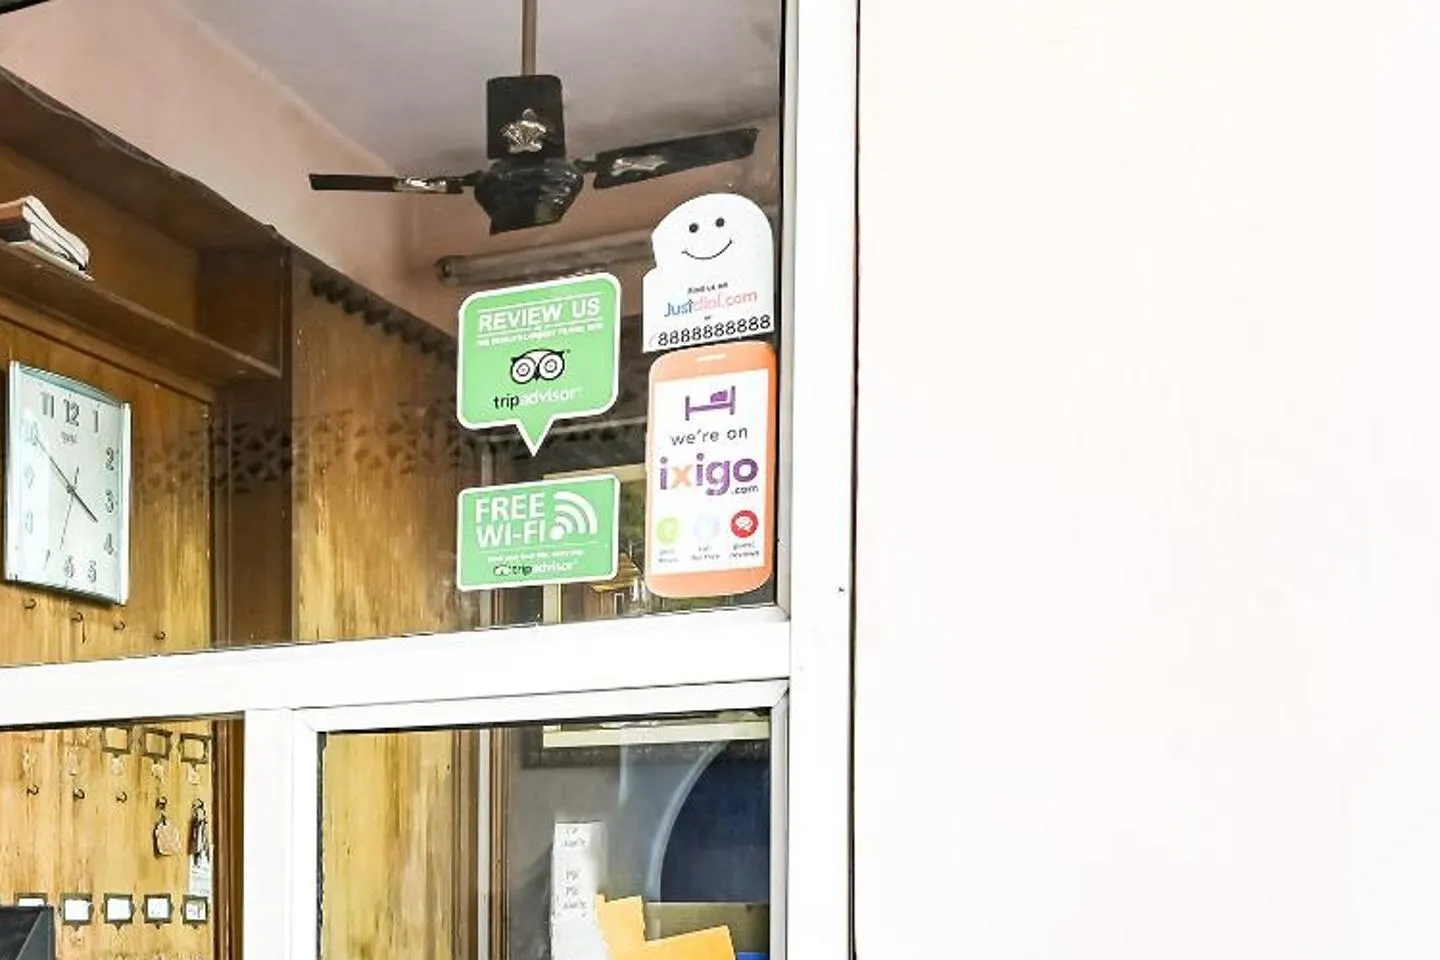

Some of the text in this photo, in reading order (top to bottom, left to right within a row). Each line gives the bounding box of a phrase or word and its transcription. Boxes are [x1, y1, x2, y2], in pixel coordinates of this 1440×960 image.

[479, 297, 601, 333] REVIEW US
[664, 291, 758, 318] Justdial.com
[658, 314, 771, 346] 8888888888
[63, 398, 80, 427] 12
[493, 387, 582, 410] tripadvisor
[670, 427, 747, 446] we're on
[660, 453, 759, 496] ixigo
[475, 492, 546, 523] FREE
[477, 519, 546, 549] WI-FI
